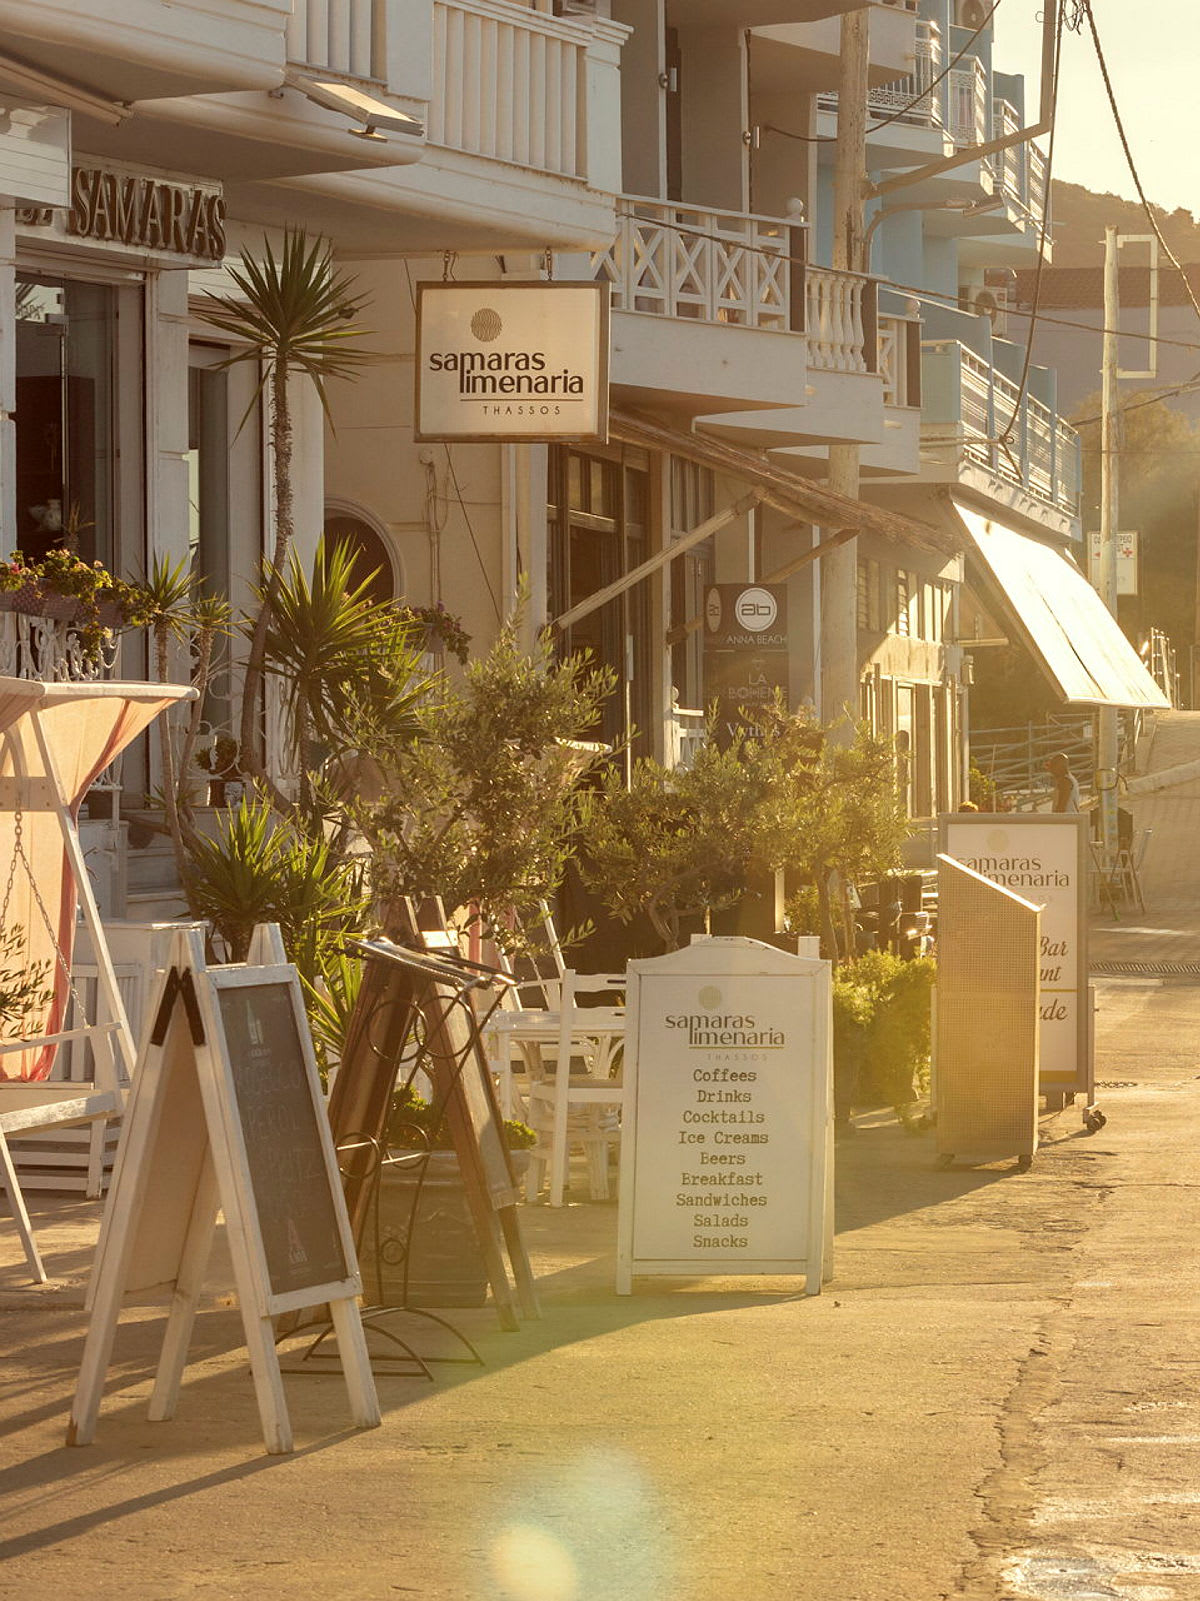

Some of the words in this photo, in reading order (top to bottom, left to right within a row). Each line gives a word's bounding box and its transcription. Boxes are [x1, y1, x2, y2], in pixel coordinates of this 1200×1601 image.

[69, 166, 227, 261] SAMARAS
[429, 352, 546, 371] samaras
[459, 369, 584, 394] limenaria
[483, 405, 561, 415] THASSOS
[727, 634, 755, 645] ANNA
[757, 634, 786, 645] BEACH
[748, 672, 767, 685] LA
[664, 1013, 756, 1030] samaras
[689, 1027, 785, 1046] limenaria
[707, 1053, 768, 1061] THASSOS
[693, 1068, 757, 1083] Coffees
[696, 1089, 752, 1104] Drinks
[683, 1110, 765, 1124] Cocktails
[678, 1130, 705, 1145] Ice
[714, 1130, 769, 1145] Creams
[700, 1151, 746, 1166] Beers
[681, 1171, 763, 1186] Breakfast
[676, 1192, 768, 1207] Sandwiches
[693, 1213, 749, 1228] Salads
[693, 1234, 748, 1249] Snacks
